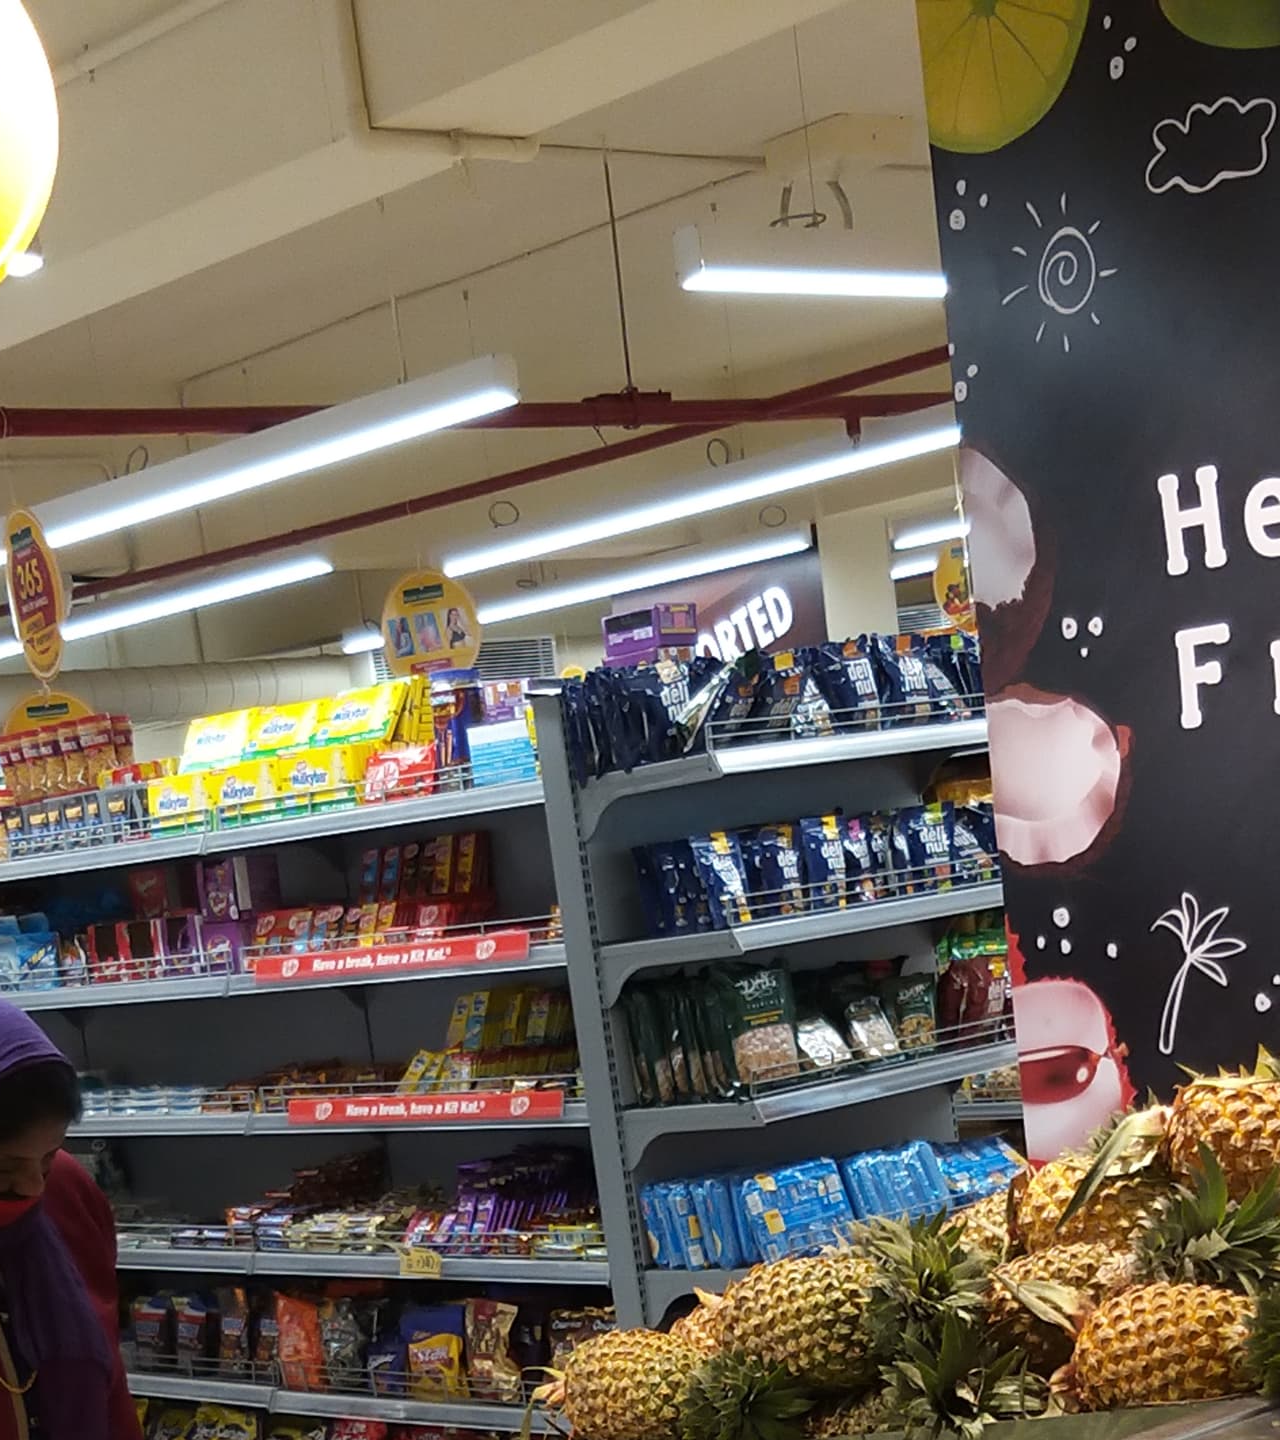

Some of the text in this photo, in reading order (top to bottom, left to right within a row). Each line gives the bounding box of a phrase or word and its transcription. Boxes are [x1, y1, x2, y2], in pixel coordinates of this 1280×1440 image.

[313, 957, 336, 972] Have
[345, 955, 374, 970] break,
[376, 952, 399, 967] have
[346, 1103, 369, 1117] Have
[379, 1103, 408, 1118] break,
[410, 1102, 433, 1116] have
